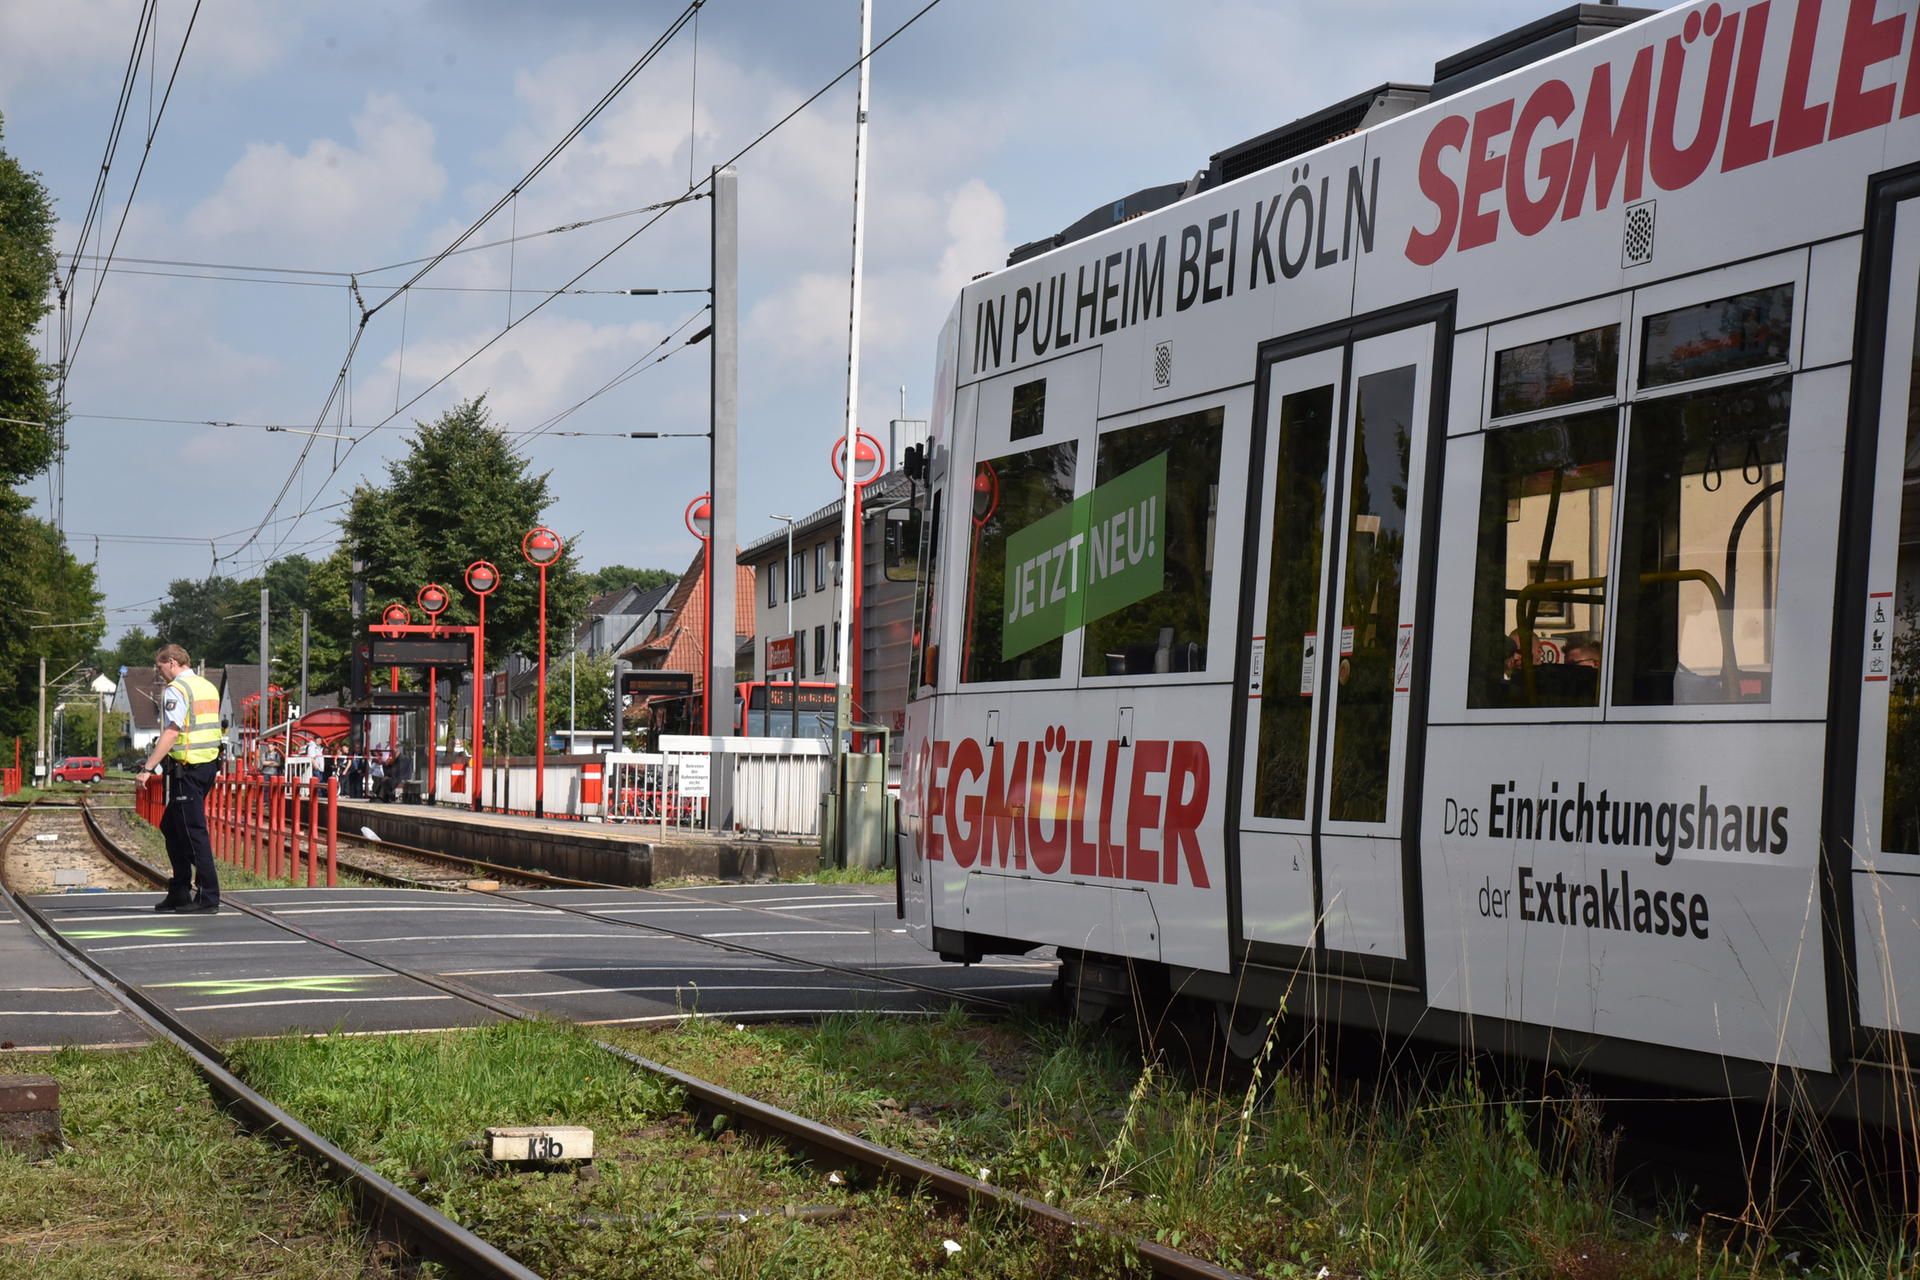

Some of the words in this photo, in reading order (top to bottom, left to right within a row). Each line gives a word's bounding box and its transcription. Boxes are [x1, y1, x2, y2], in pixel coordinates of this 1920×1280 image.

[1404, 0, 1920, 267] SEGMÜLLE
[973, 294, 1006, 375] IN
[1011, 235, 1168, 363] PULHEIM
[1176, 208, 1240, 312] BEI
[1249, 156, 1381, 290] KÖLN
[1008, 532, 1084, 624] JETZT
[1089, 495, 1156, 585] NEU!
[1443, 797, 1479, 837] Das
[1488, 780, 1789, 866] Einrichtungshaus
[1478, 875, 1511, 919] der
[1518, 866, 1710, 940] Extraklasse
[528, 1136, 564, 1160] K3b
